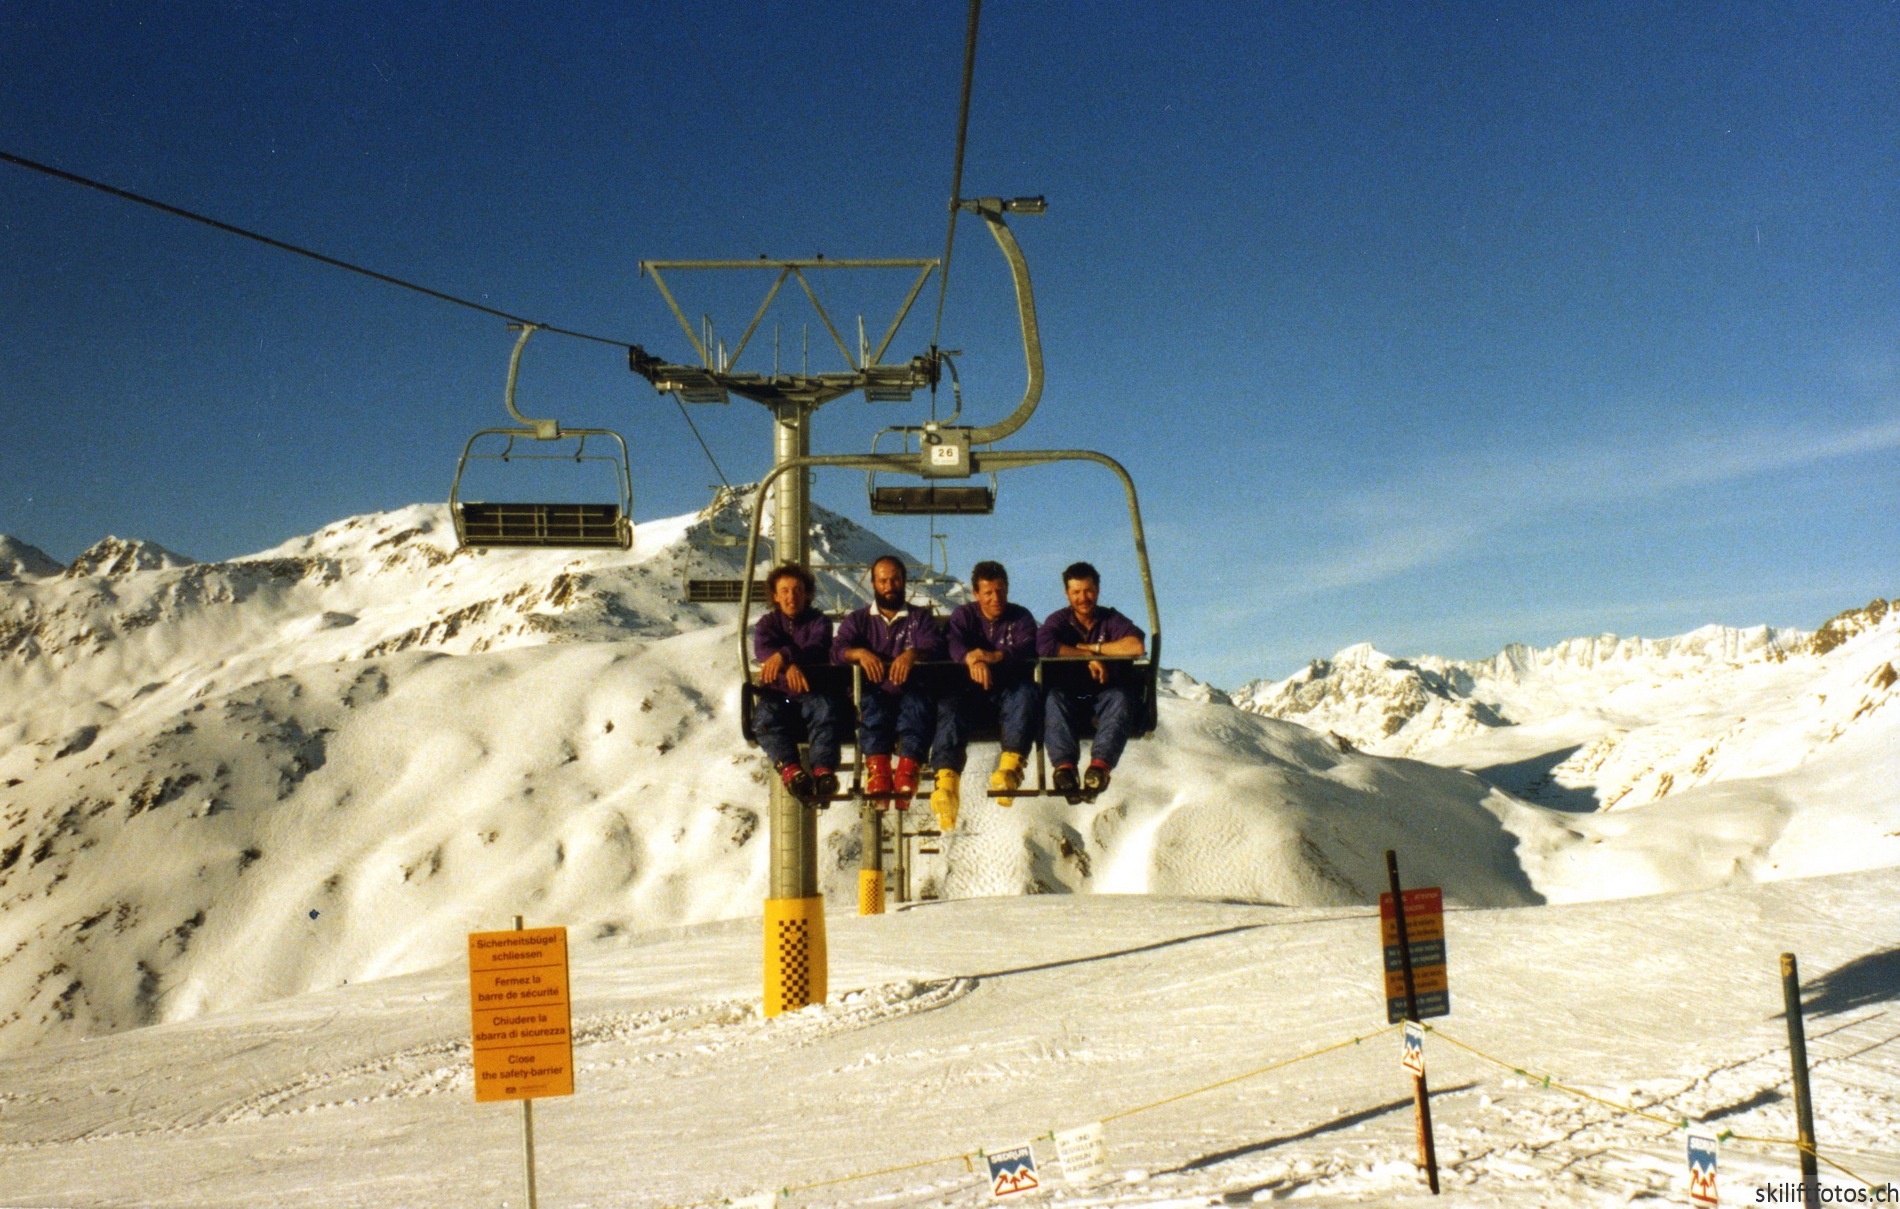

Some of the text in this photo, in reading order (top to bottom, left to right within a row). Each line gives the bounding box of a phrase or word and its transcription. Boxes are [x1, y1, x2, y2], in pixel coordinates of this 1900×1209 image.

[938, 448, 953, 457] 26
[477, 934, 557, 949] Sicherheitsbügel
[492, 950, 542, 962] schliessen
[495, 974, 541, 987] Fermez la
[478, 986, 559, 1002] barre de sécurité
[493, 1013, 547, 1026] Chiudere la
[476, 1026, 566, 1041] sbarra di sicurezza
[508, 1054, 535, 1064] Close
[482, 1066, 563, 1081] the safety-barrier
[990, 1147, 1029, 1164] SEDRUN
